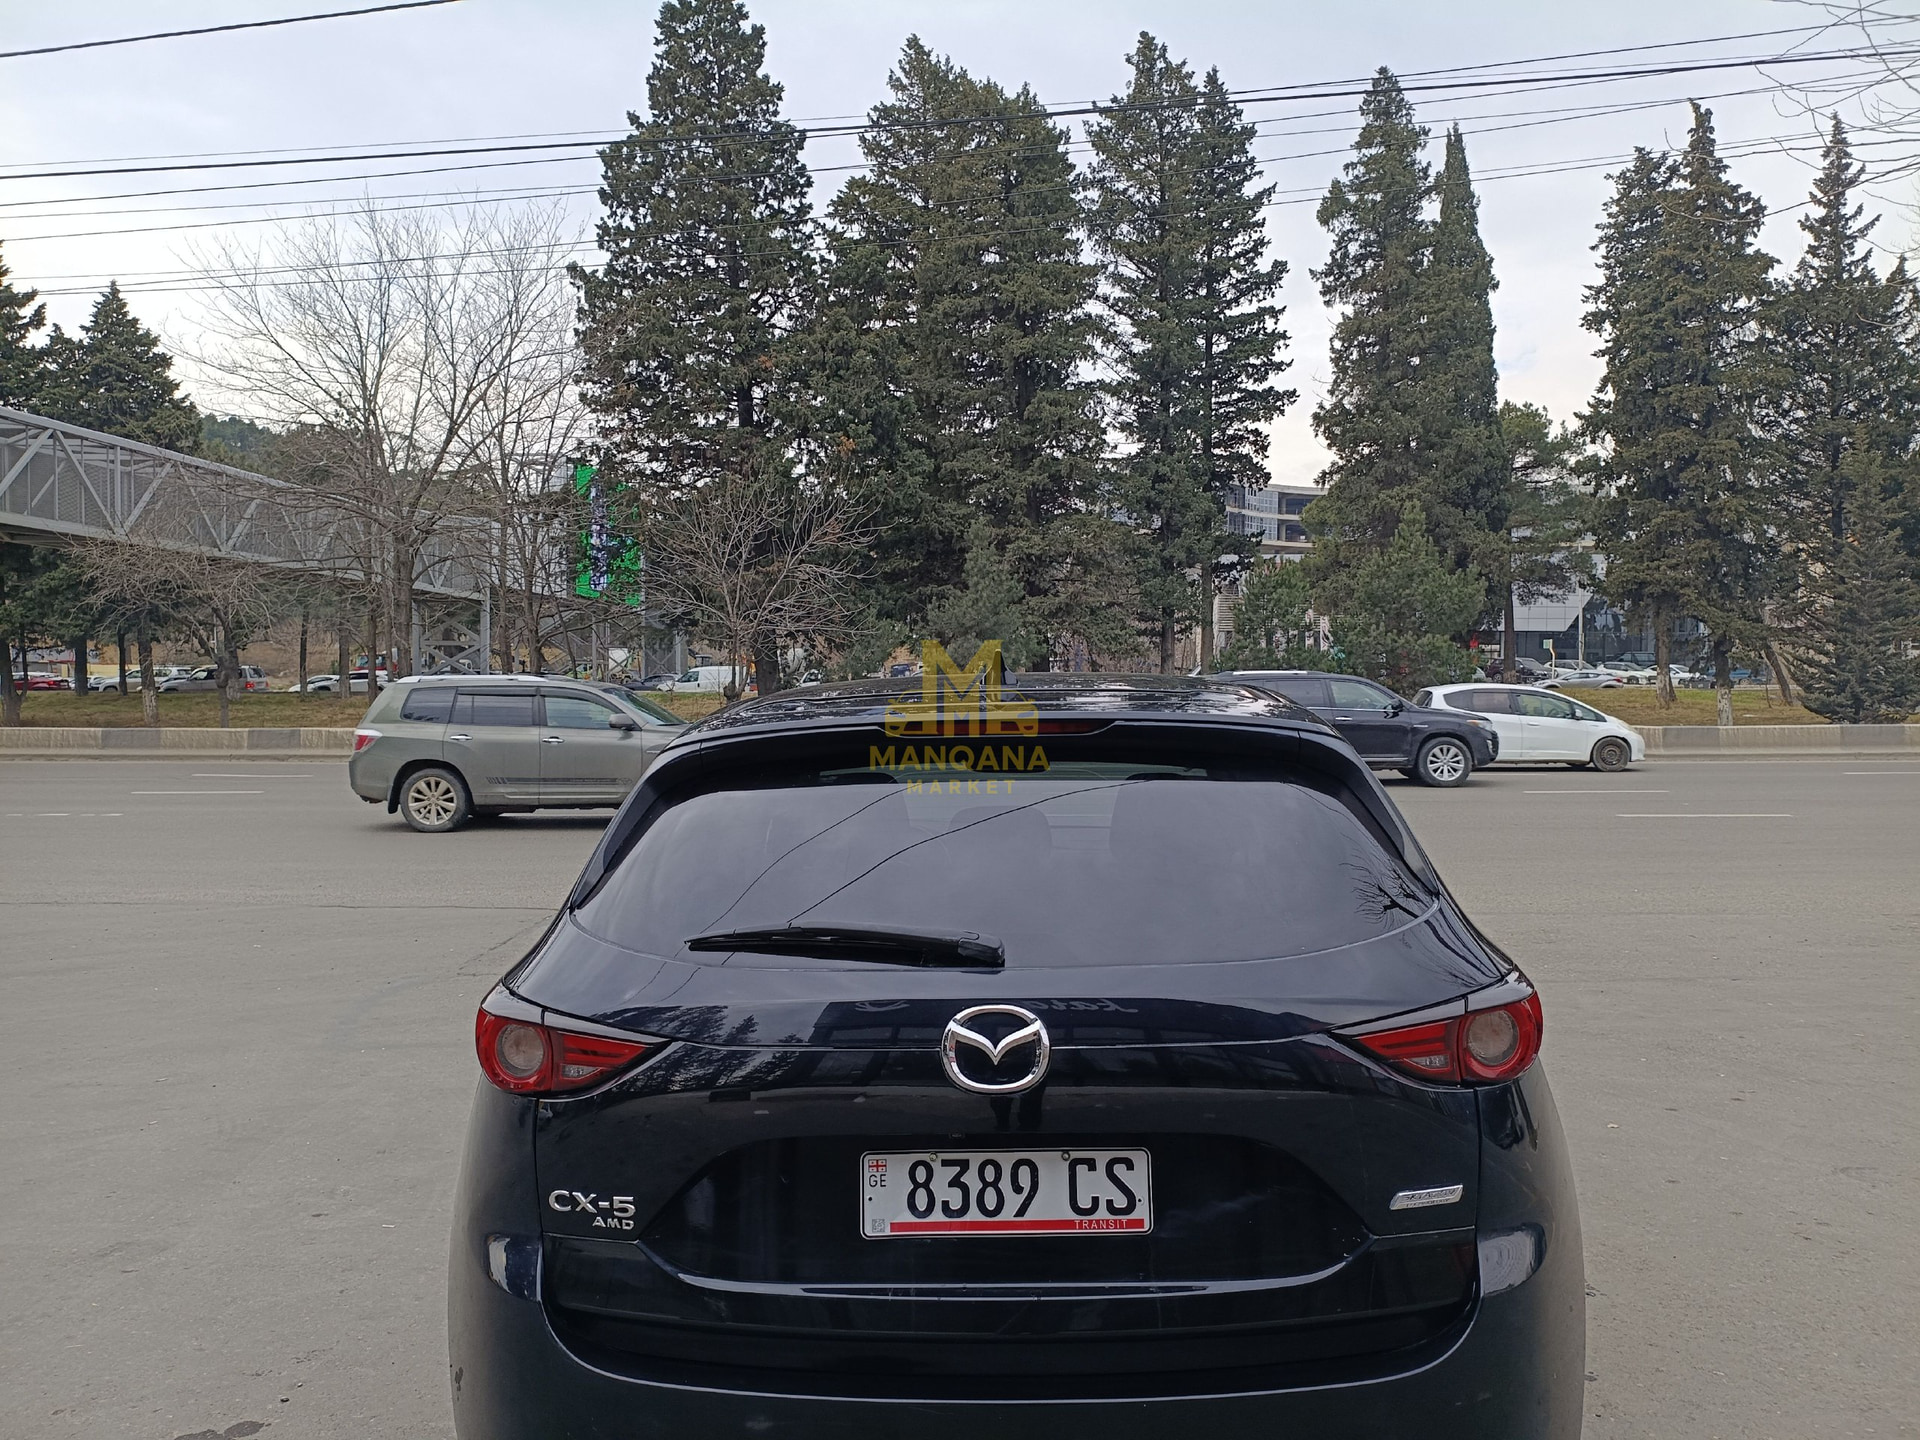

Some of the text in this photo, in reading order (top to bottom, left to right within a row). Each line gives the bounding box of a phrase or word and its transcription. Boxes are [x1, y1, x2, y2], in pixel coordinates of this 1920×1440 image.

[868, 1174, 887, 1188] GE
[906, 1156, 1138, 1219] 8389 CS
[548, 1189, 636, 1218] CX-5
[1074, 1218, 1128, 1230] TRANSIT
